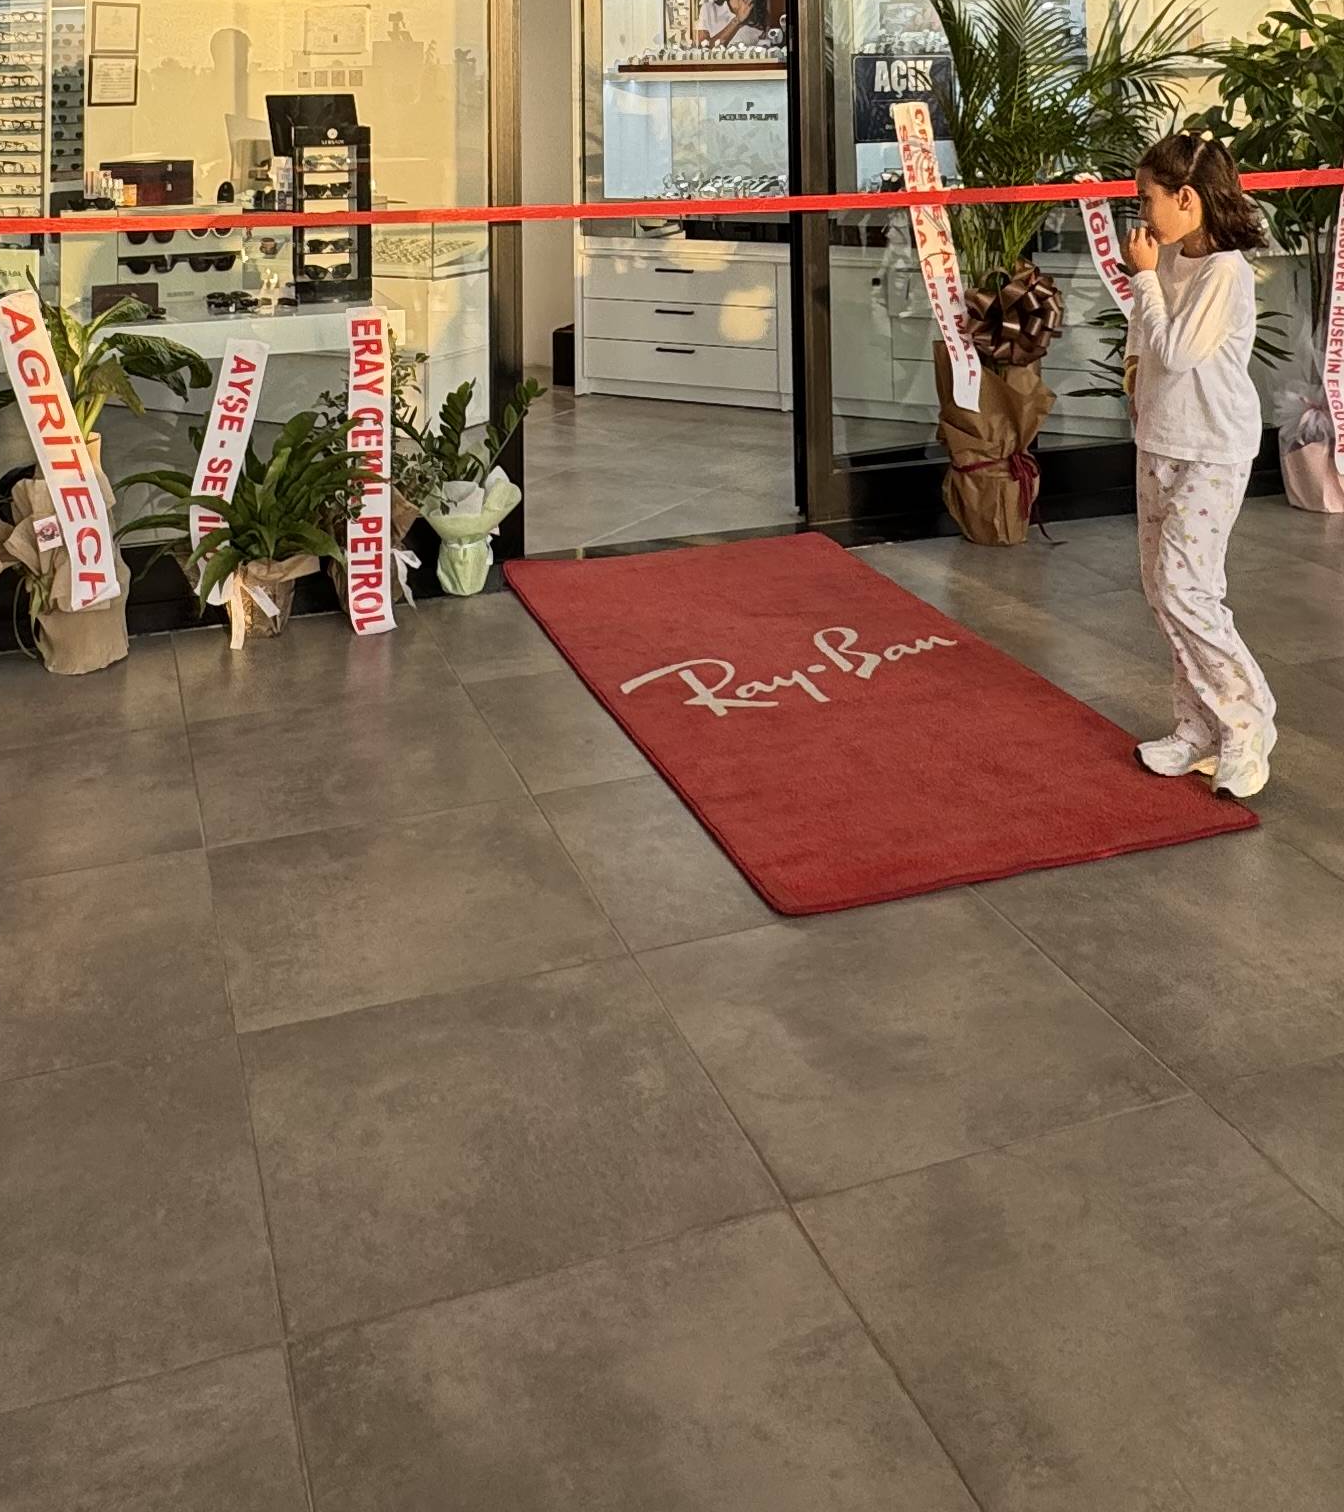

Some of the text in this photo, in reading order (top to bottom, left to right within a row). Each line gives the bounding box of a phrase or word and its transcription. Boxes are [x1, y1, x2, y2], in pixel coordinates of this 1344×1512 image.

[352, 319, 384, 395] ERAY
[953, 314, 977, 386] MALL
[218, 355, 256, 433] AYŞE
[351, 516, 385, 631] PETROL
[620, 626, 958, 717] Ray-Ban
